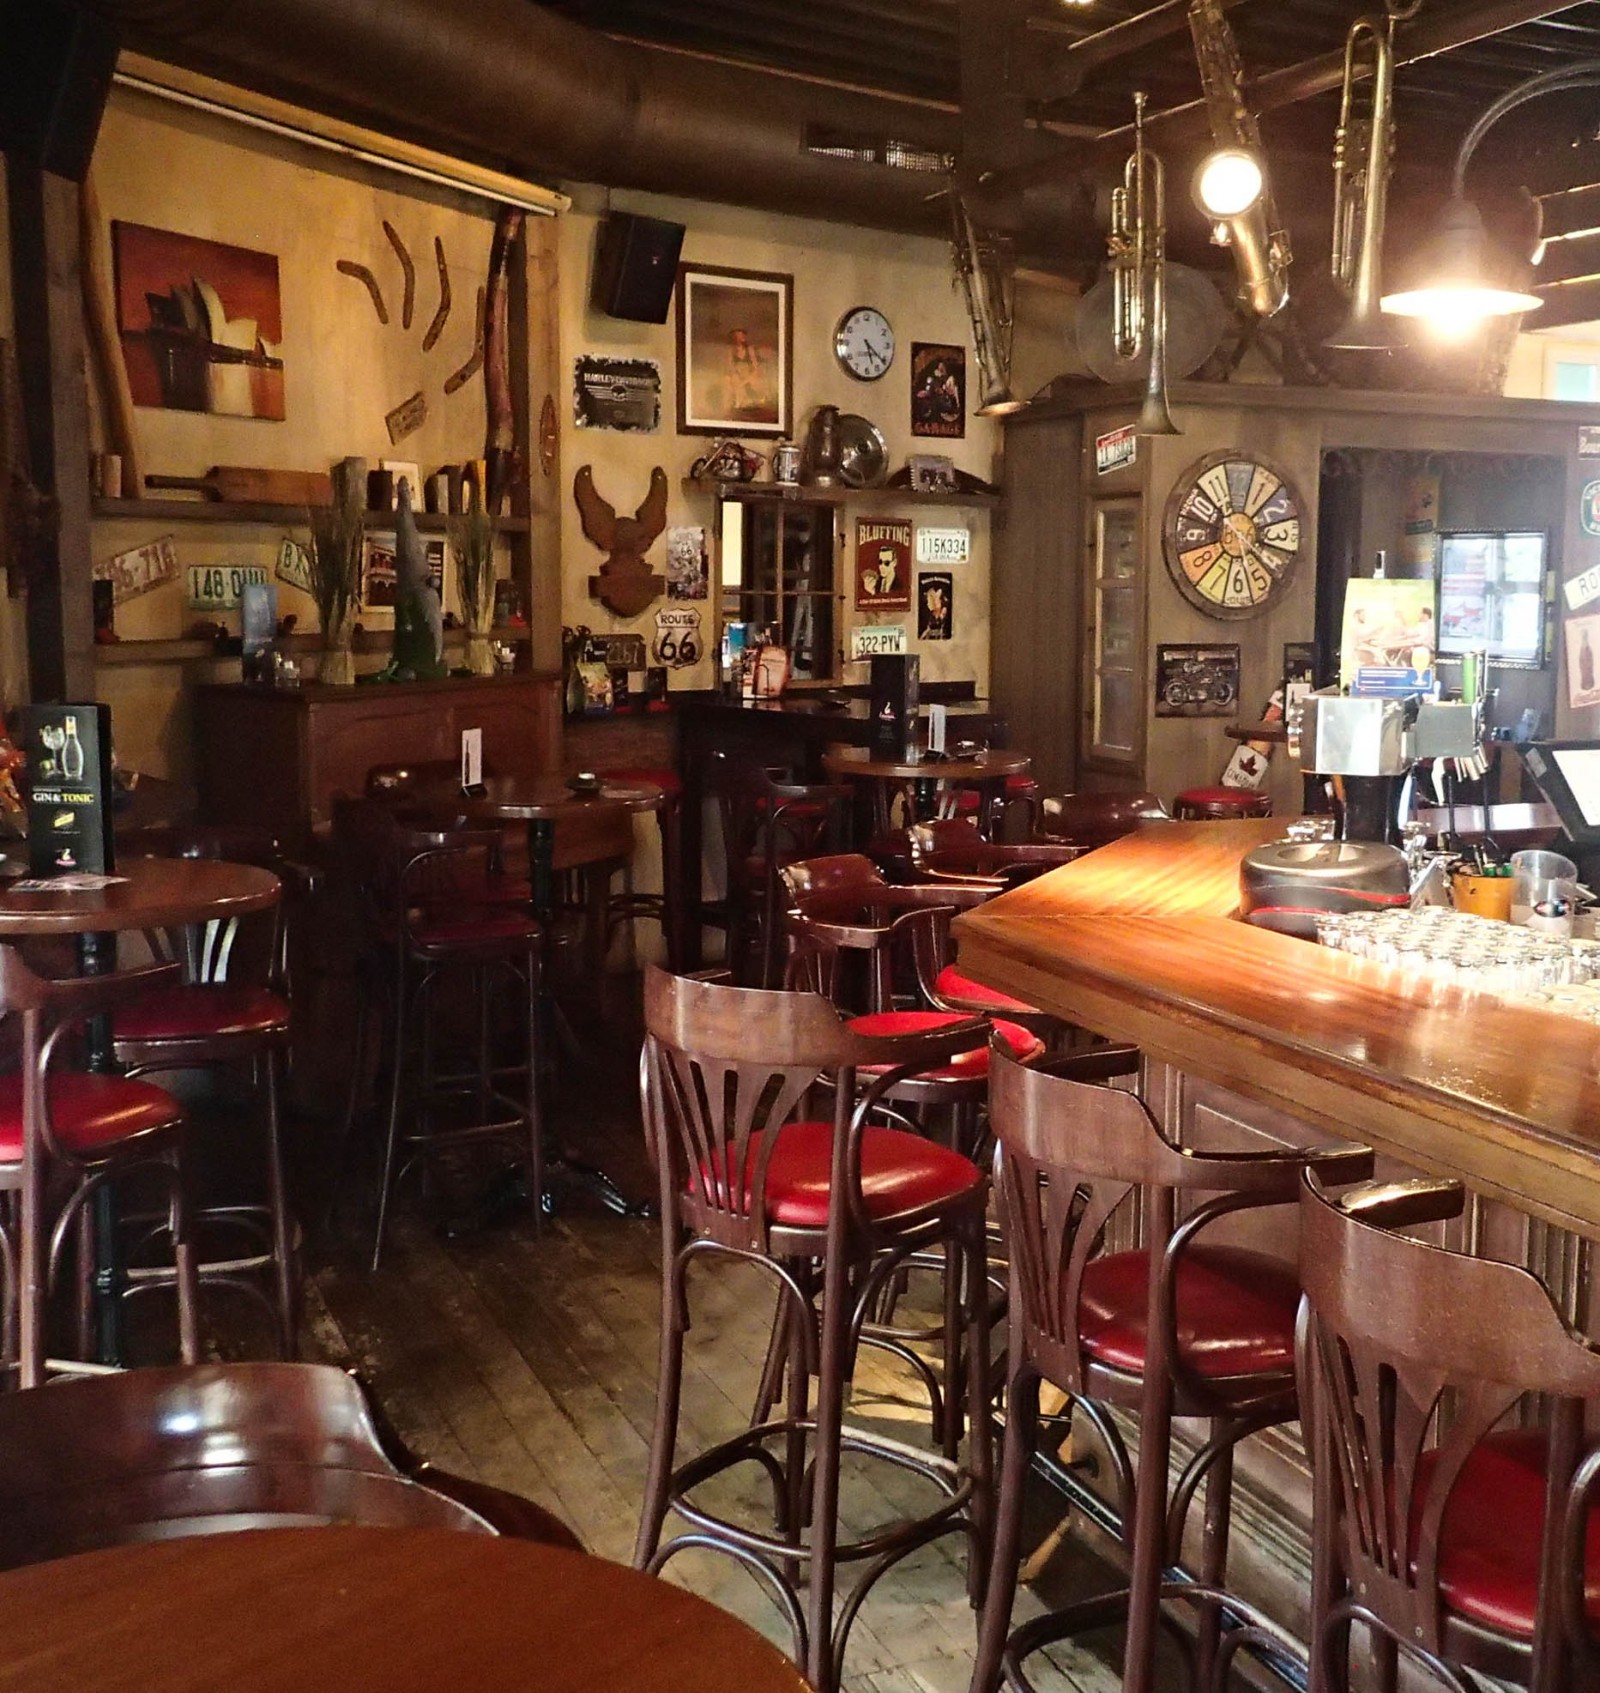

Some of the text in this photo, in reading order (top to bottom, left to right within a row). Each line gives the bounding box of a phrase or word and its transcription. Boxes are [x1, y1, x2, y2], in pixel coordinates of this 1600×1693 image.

[1208, 475, 1227, 503] 11
[1190, 495, 1214, 523] 10
[1263, 499, 1287, 523] 2
[859, 525, 910, 547] BLUFFING
[1186, 528, 1206, 541] 9
[1265, 528, 1289, 542] 3
[1193, 550, 1213, 568] 8
[1210, 564, 1227, 591] 7
[1233, 569, 1244, 594] 6
[1251, 567, 1268, 591] 5
[660, 614, 695, 625] ROUTE
[660, 631, 696, 661] 66
[33, 792, 51, 802] GIN
[61, 794, 95, 803] TONIC
